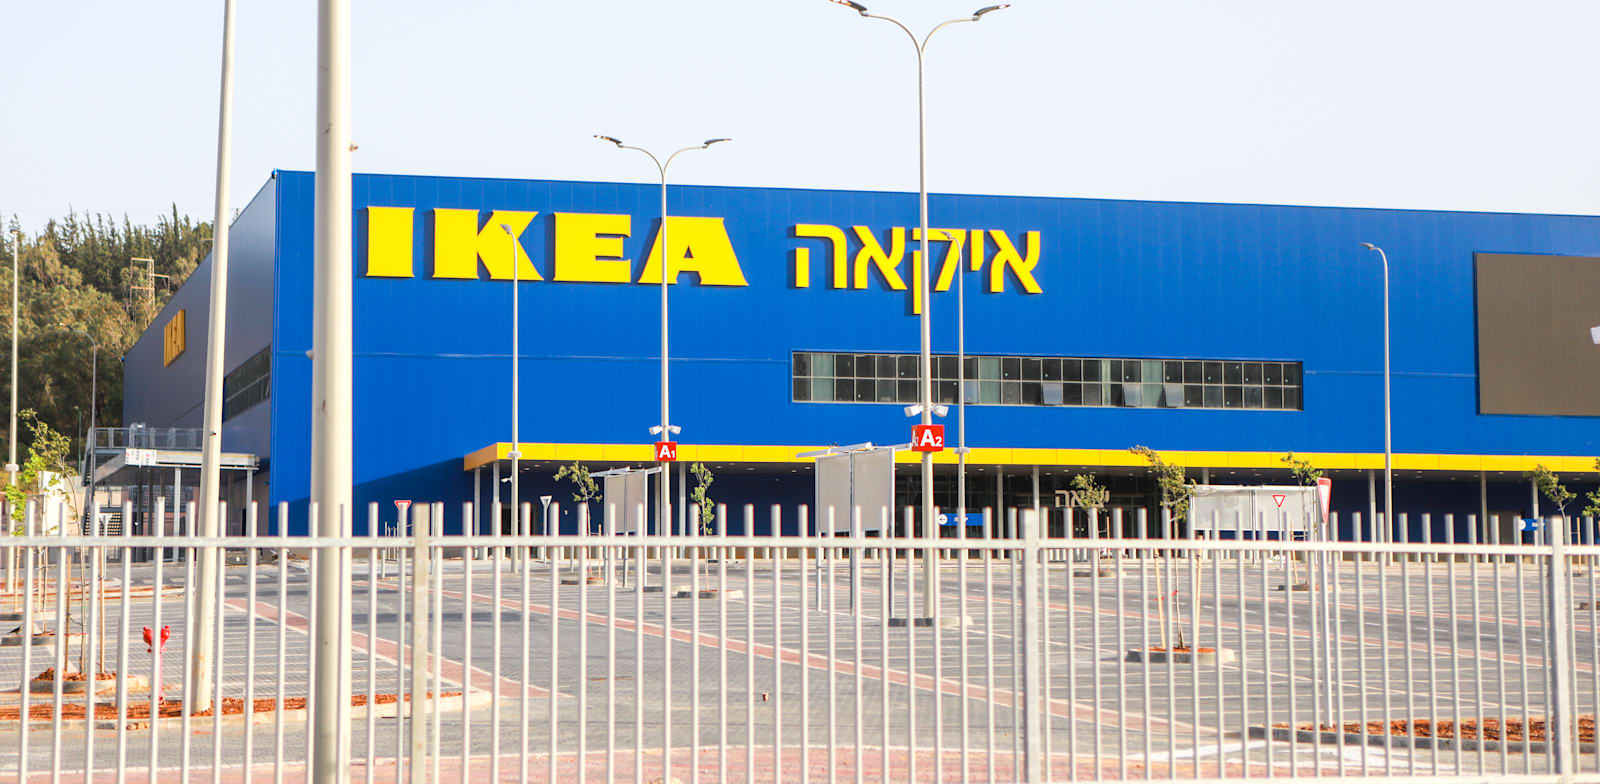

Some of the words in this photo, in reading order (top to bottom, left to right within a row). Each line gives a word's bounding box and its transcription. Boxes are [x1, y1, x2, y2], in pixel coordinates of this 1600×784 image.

[366, 205, 749, 286] IKEA
[795, 223, 1043, 315] איקאה
[659, 445, 675, 458] A1
[920, 429, 942, 447] A2
